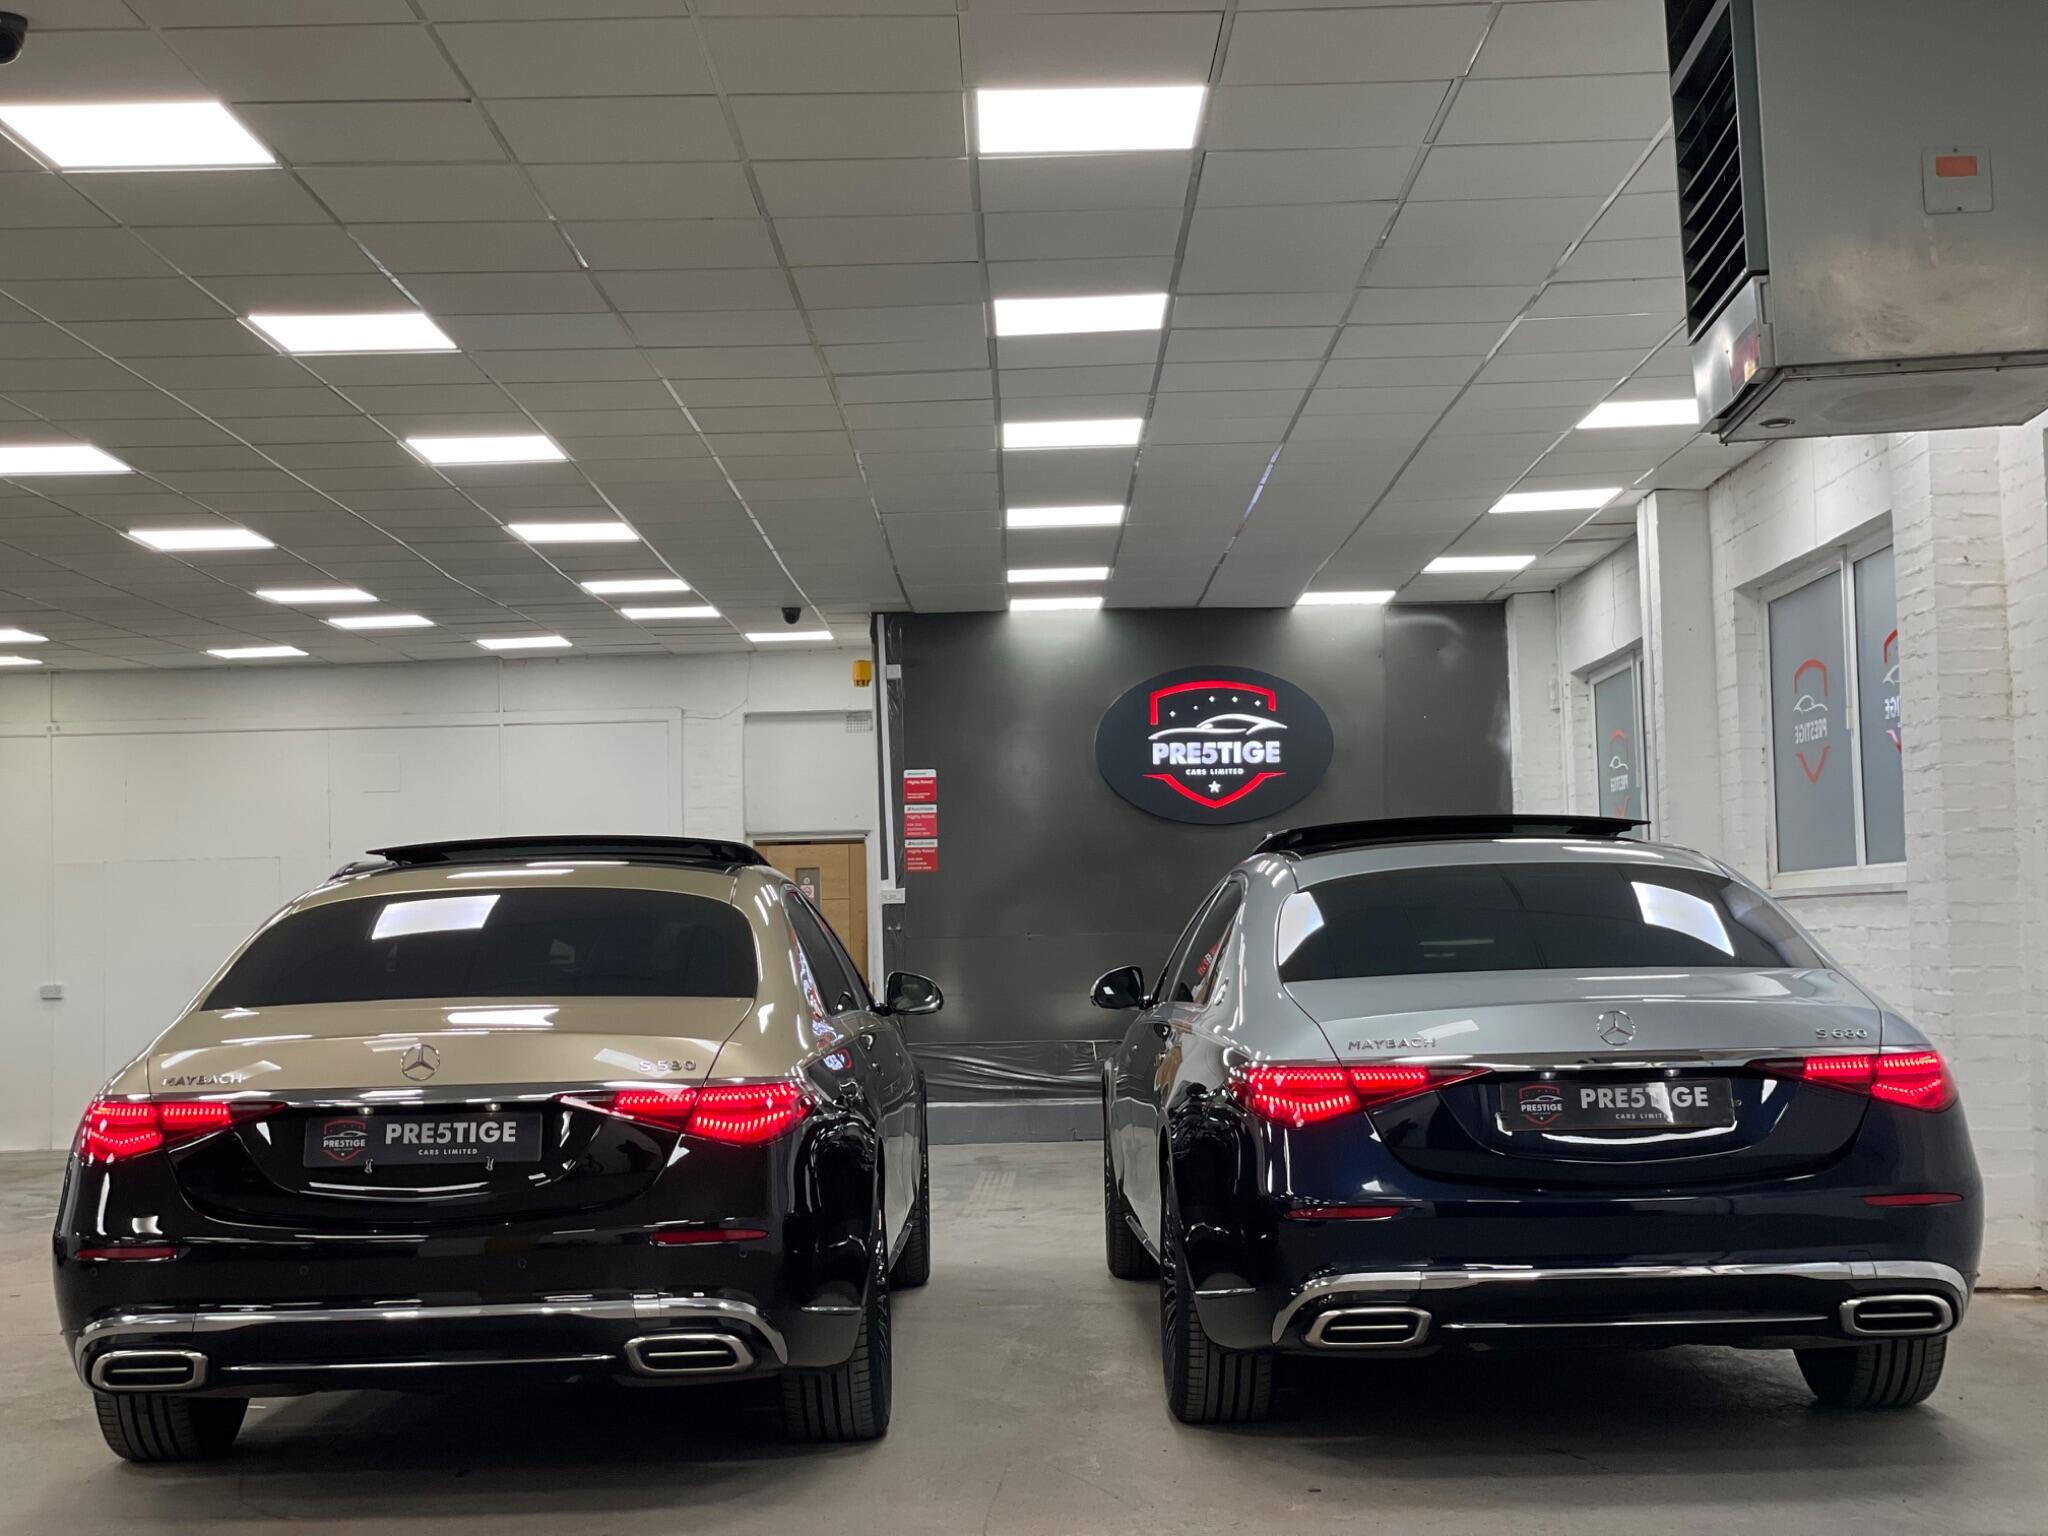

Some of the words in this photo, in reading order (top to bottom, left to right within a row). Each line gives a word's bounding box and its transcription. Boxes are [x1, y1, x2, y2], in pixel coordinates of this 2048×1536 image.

[1152, 741, 1281, 766] PRE5TIGE
[1185, 768, 1207, 776] CARS
[1210, 767, 1245, 775] LIMITED
[1815, 1027, 1828, 1039] S
[1831, 1027, 1868, 1039] 680
[1348, 1037, 1437, 1051] MAYBACH
[639, 1060, 652, 1072] S
[1579, 1086, 1709, 1109] PRE5TGE
[385, 1121, 517, 1145] PRE5TIGE
[418, 1148, 440, 1156] CARS
